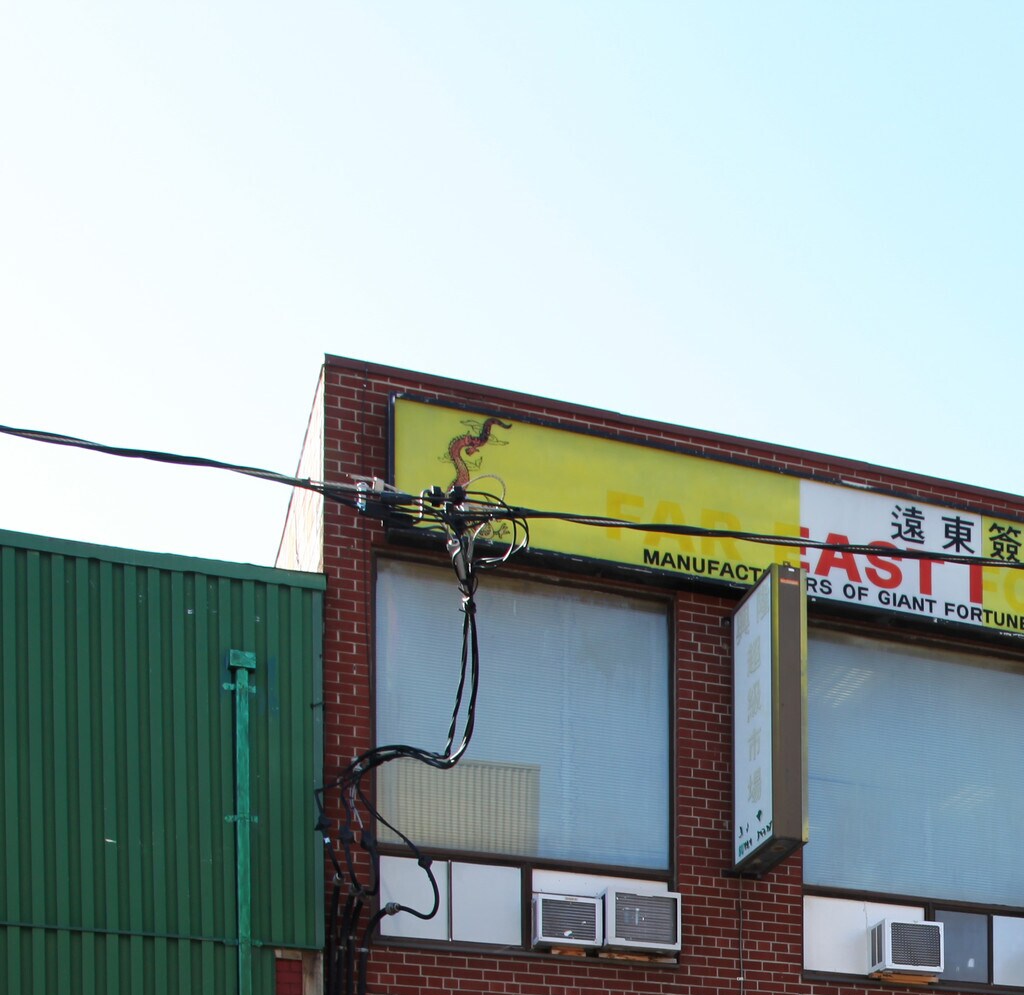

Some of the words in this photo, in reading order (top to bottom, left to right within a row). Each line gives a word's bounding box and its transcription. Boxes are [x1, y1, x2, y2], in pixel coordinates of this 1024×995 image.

[606, 490, 742, 561] FAR
[774, 522, 945, 596] EAST
[643, 548, 832, 595] MANUFACTRS
[842, 583, 869, 601] OF
[878, 589, 937, 614] GIANT
